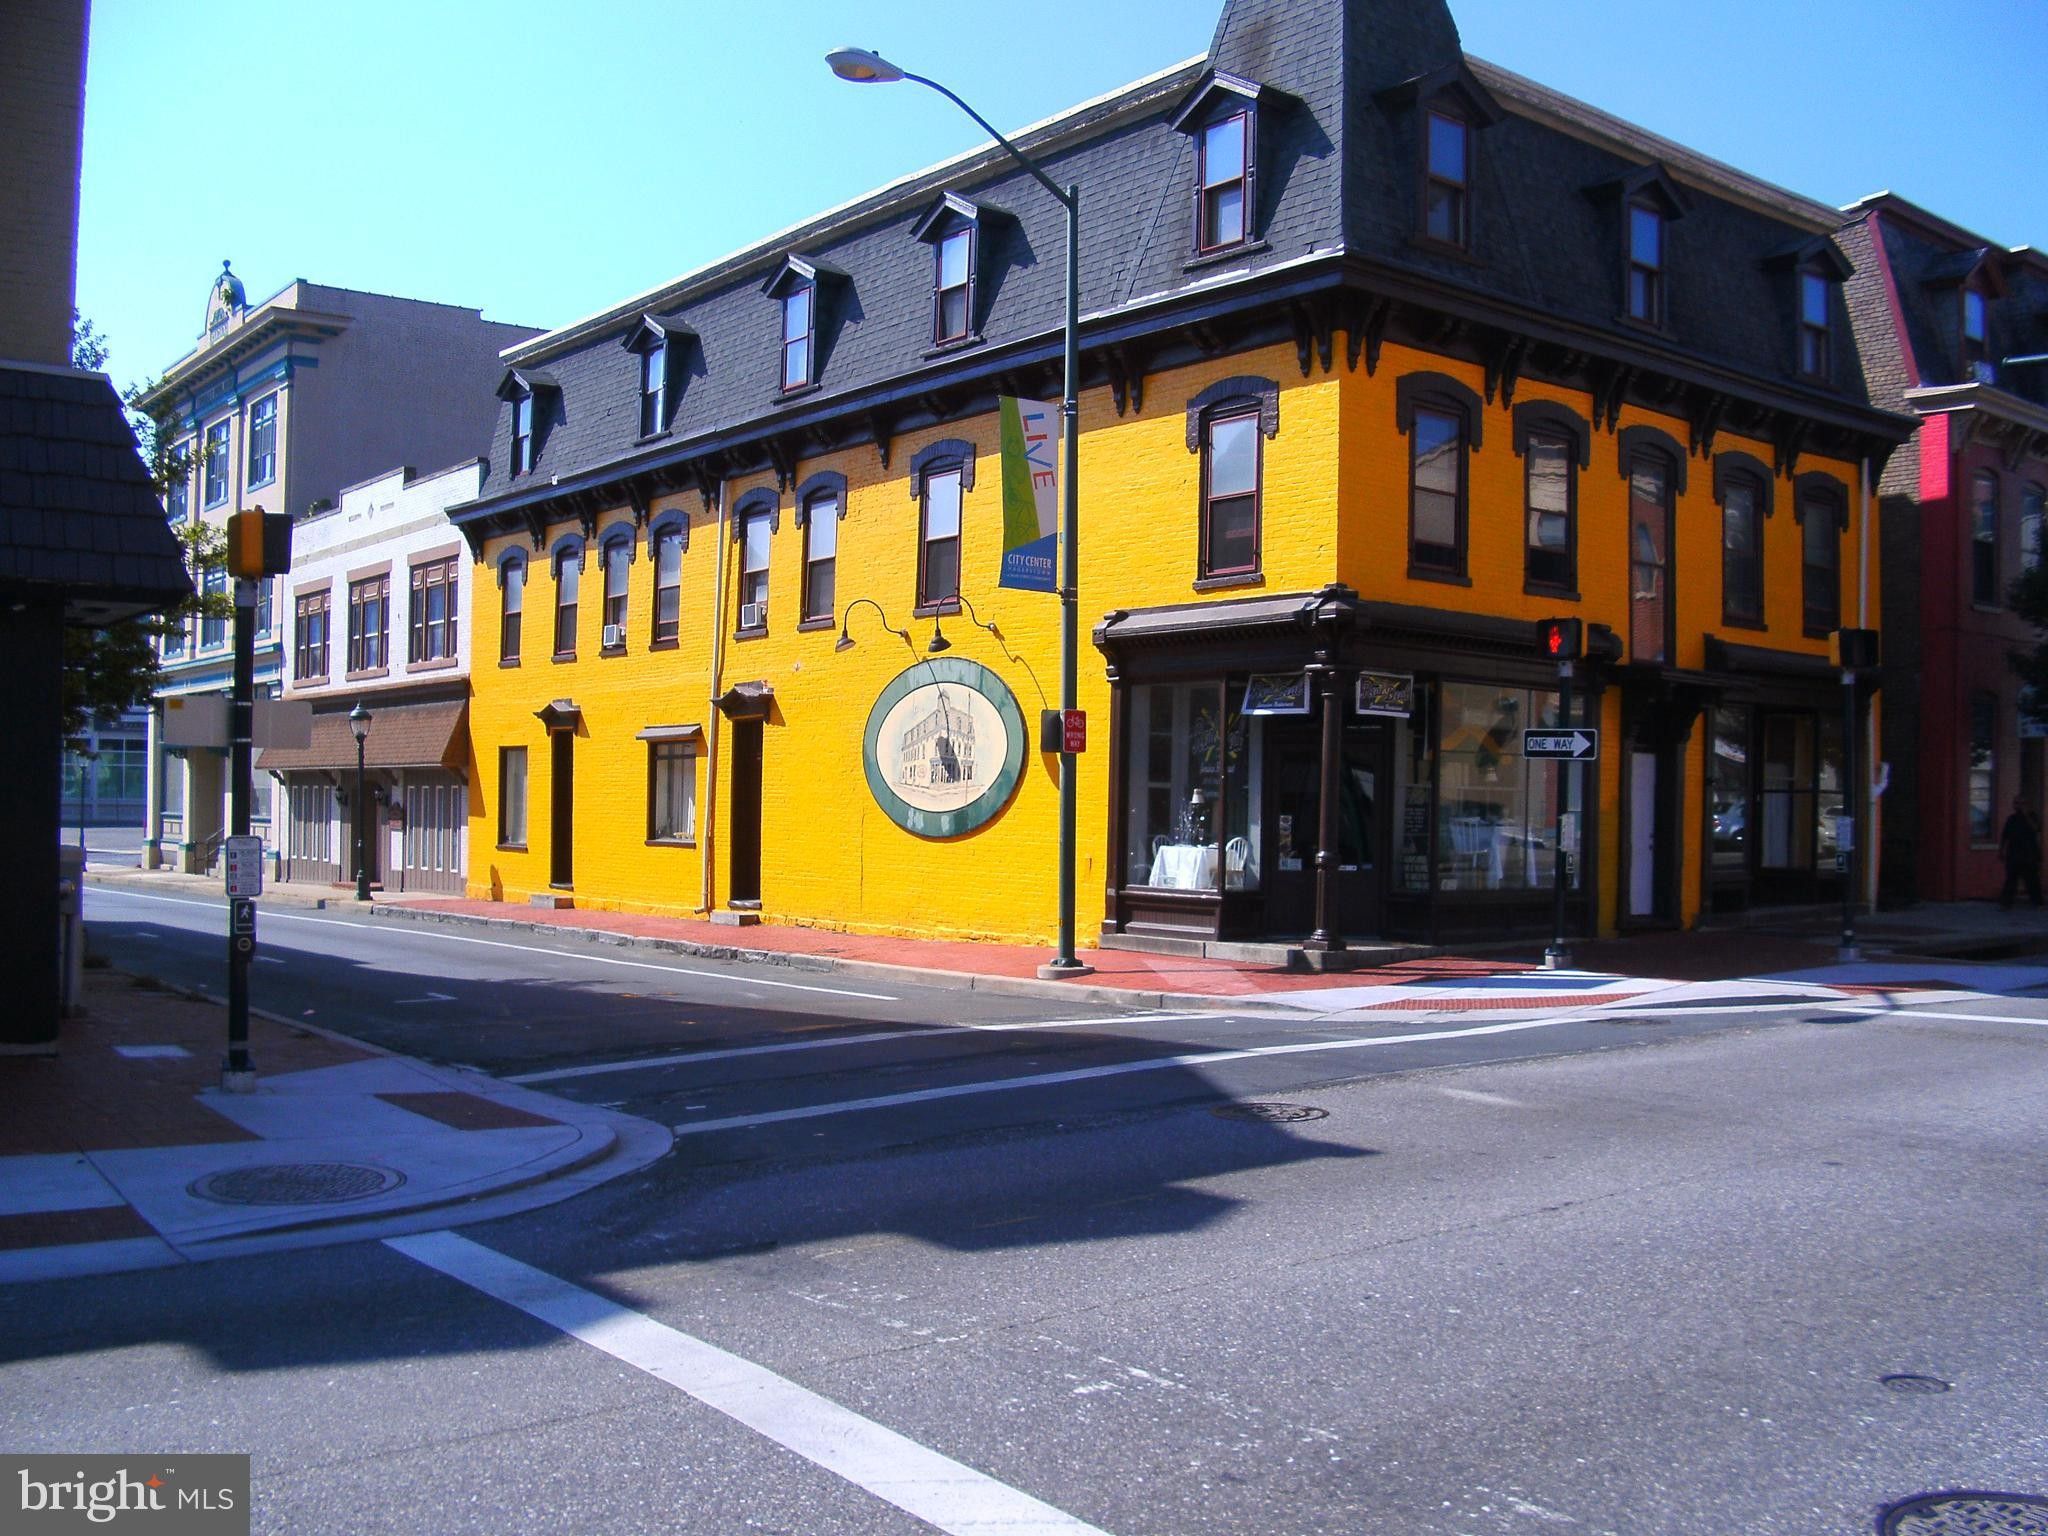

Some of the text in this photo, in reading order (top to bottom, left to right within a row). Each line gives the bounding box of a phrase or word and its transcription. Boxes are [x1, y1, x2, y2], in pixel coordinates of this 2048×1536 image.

[1023, 412, 1056, 490] LIVE
[1007, 553, 1052, 569] CITY CENTER
[1528, 738, 1574, 749] ONE WAY
